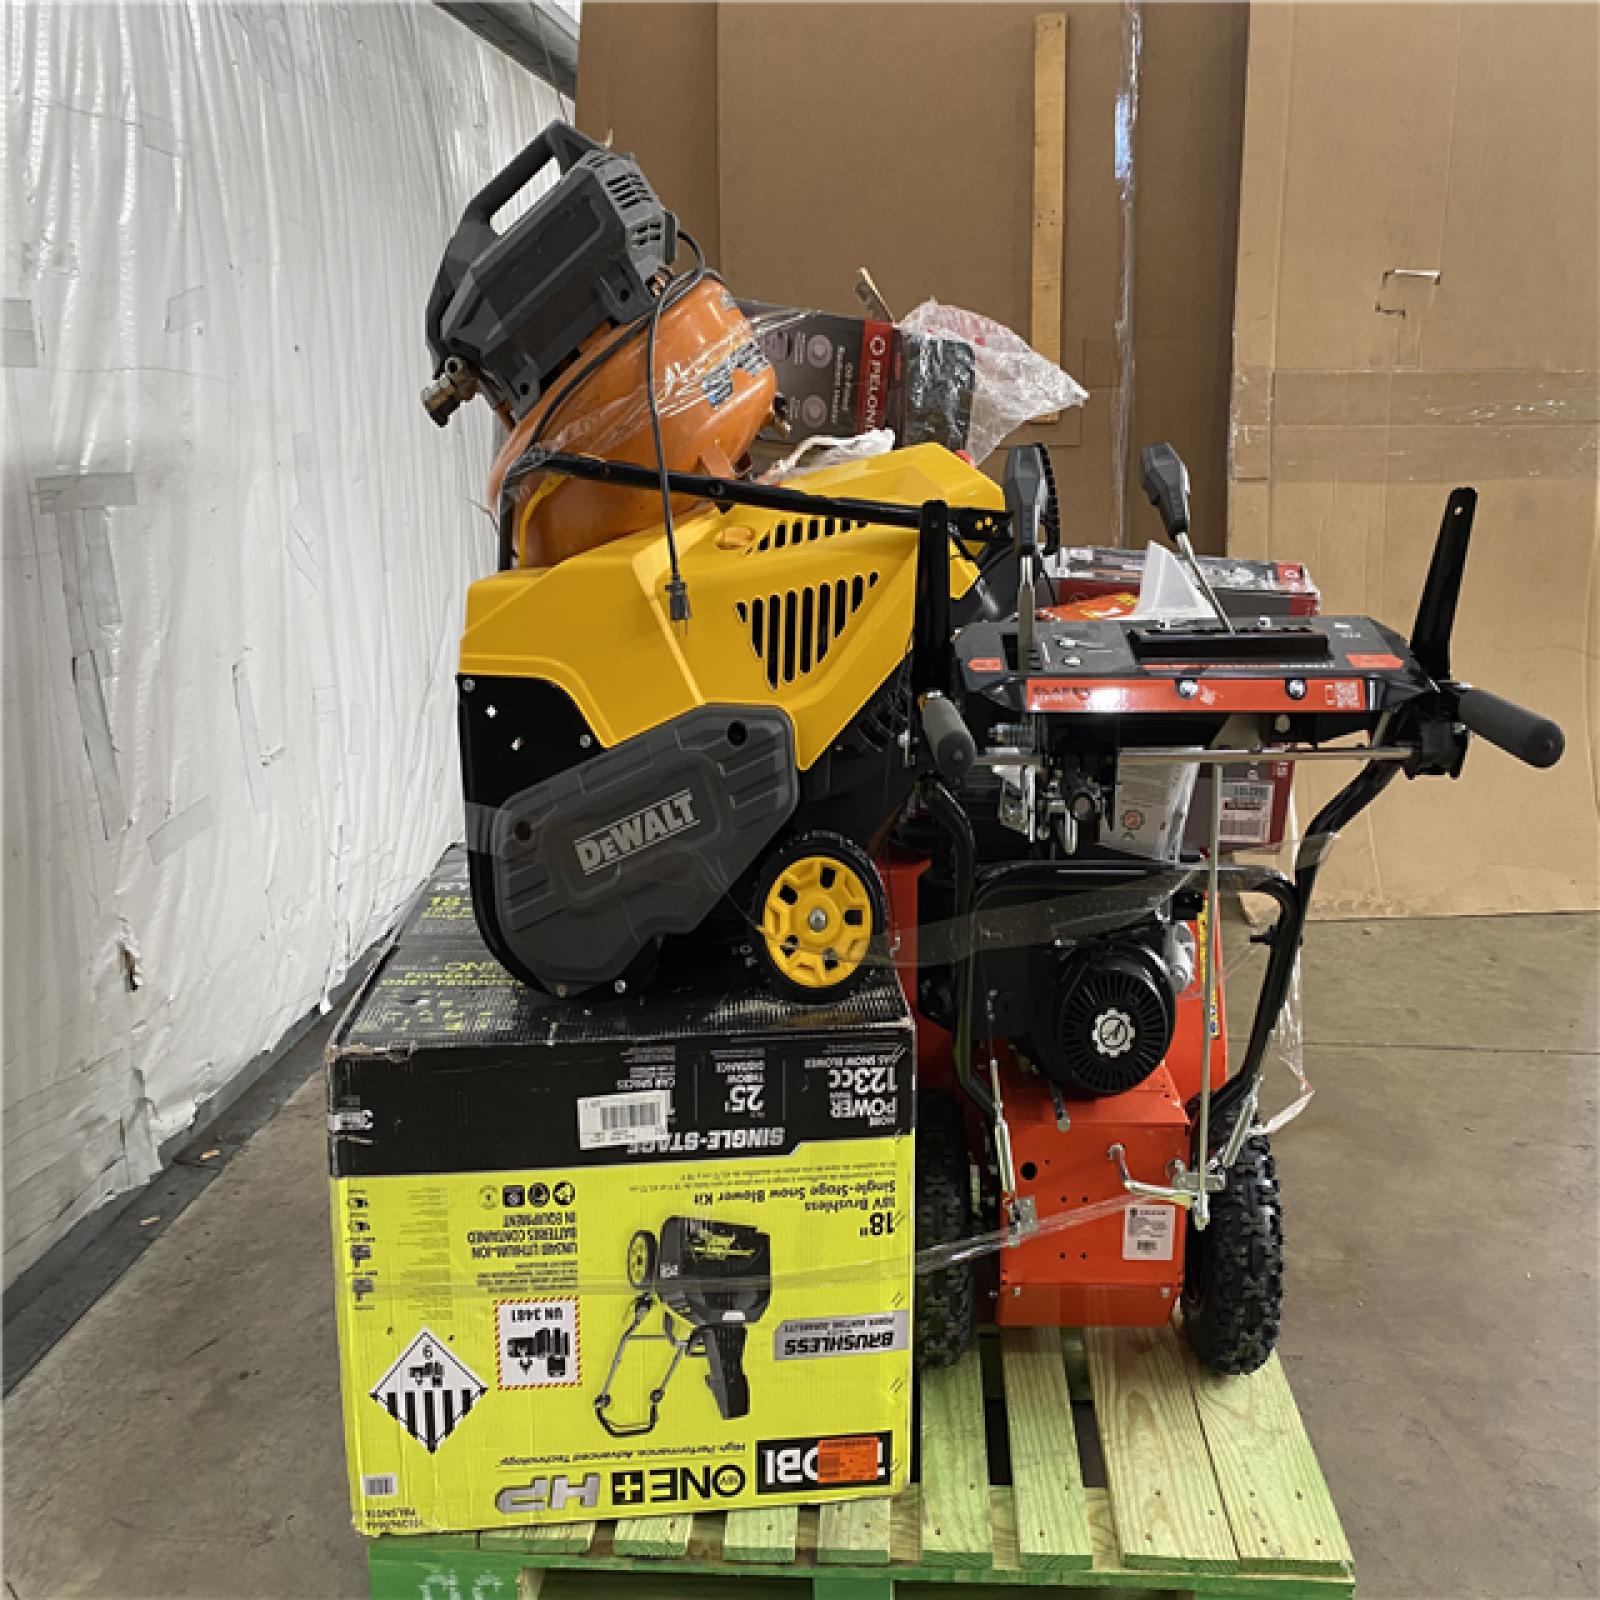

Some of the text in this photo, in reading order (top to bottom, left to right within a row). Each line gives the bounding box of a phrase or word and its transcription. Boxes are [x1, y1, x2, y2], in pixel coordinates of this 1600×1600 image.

[829, 1066, 897, 1093] 123cc
[830, 1097, 896, 1118] POWER
[718, 1190, 766, 1203] Blower
[770, 1188, 806, 1200] Snow
[859, 1211, 896, 1237] 18"
[512, 1308, 540, 1322] 3481
[784, 1332, 893, 1356] BRUSHLESS
[494, 1472, 600, 1514] HP
